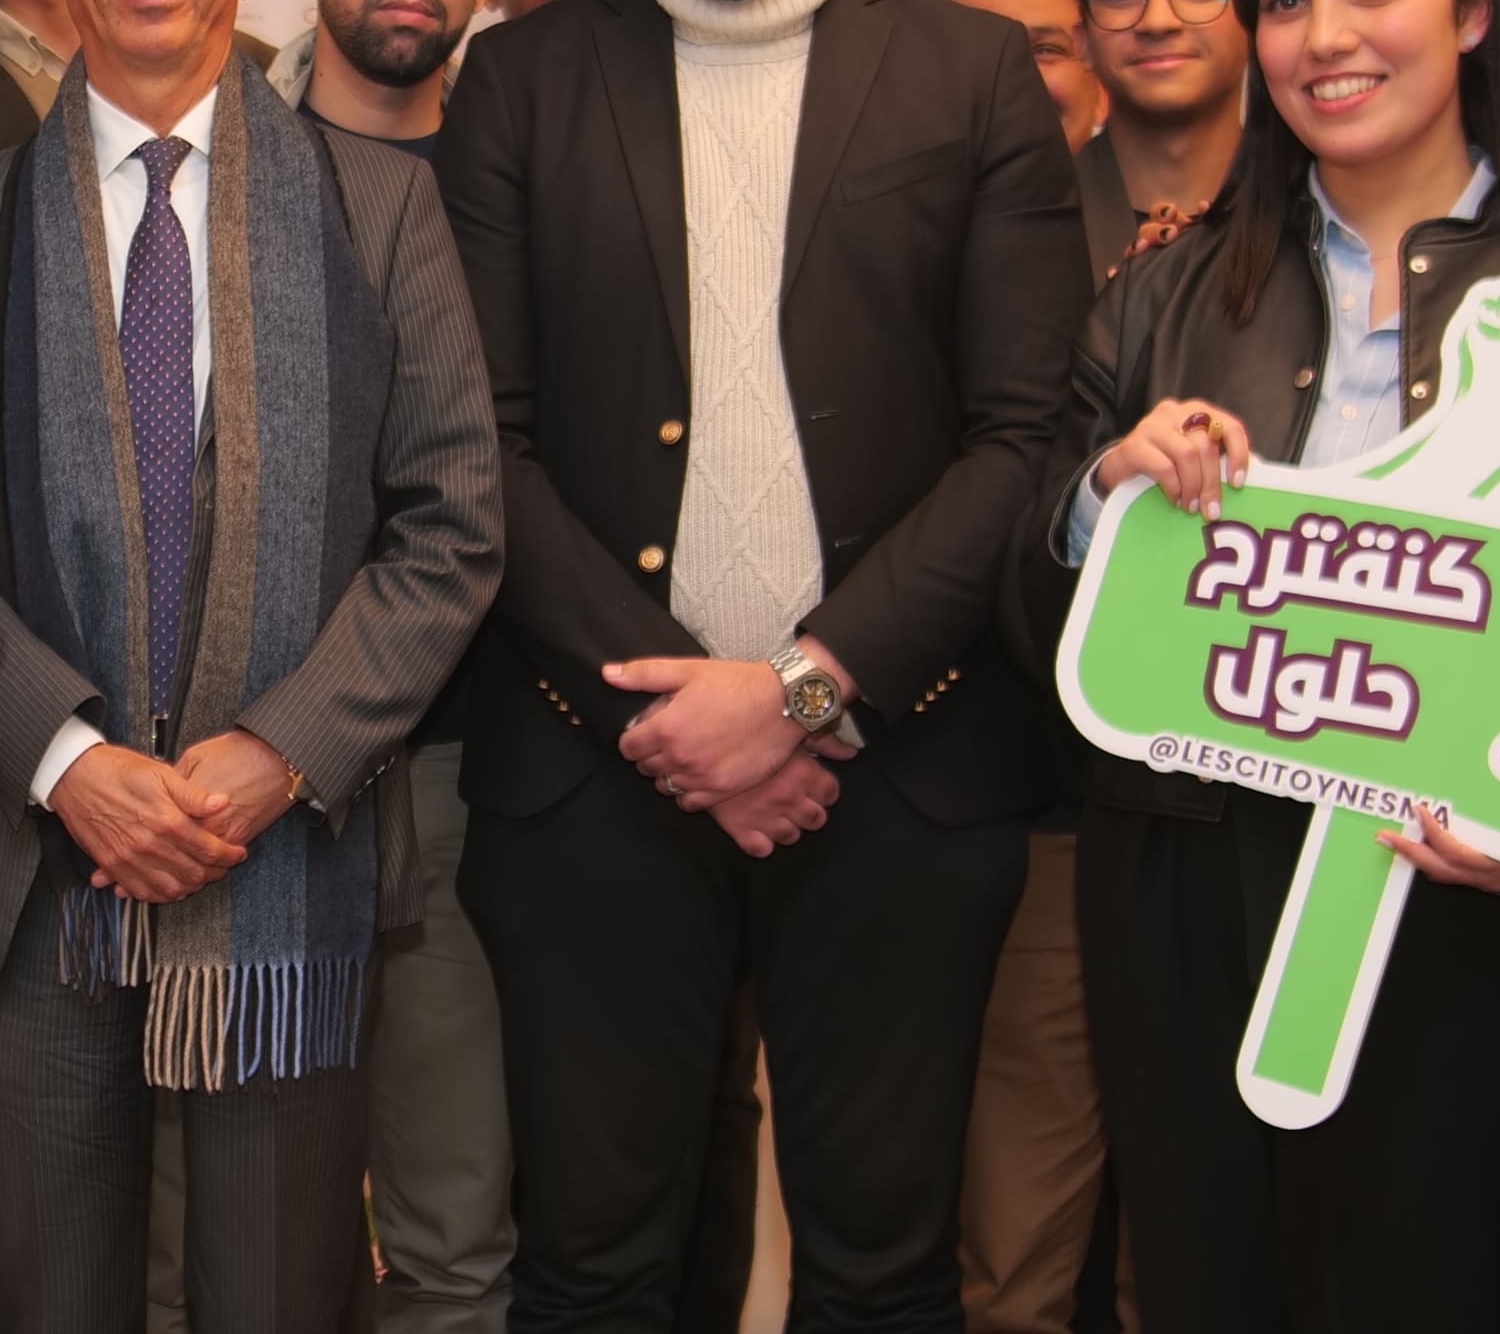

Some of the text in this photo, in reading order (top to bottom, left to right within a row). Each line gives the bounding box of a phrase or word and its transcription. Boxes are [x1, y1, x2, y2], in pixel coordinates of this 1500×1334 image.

[1191, 515, 1487, 628] كنقترح
[1208, 629, 1417, 738] حلول
[1148, 735, 1451, 830] @LESCITOYNESMA
